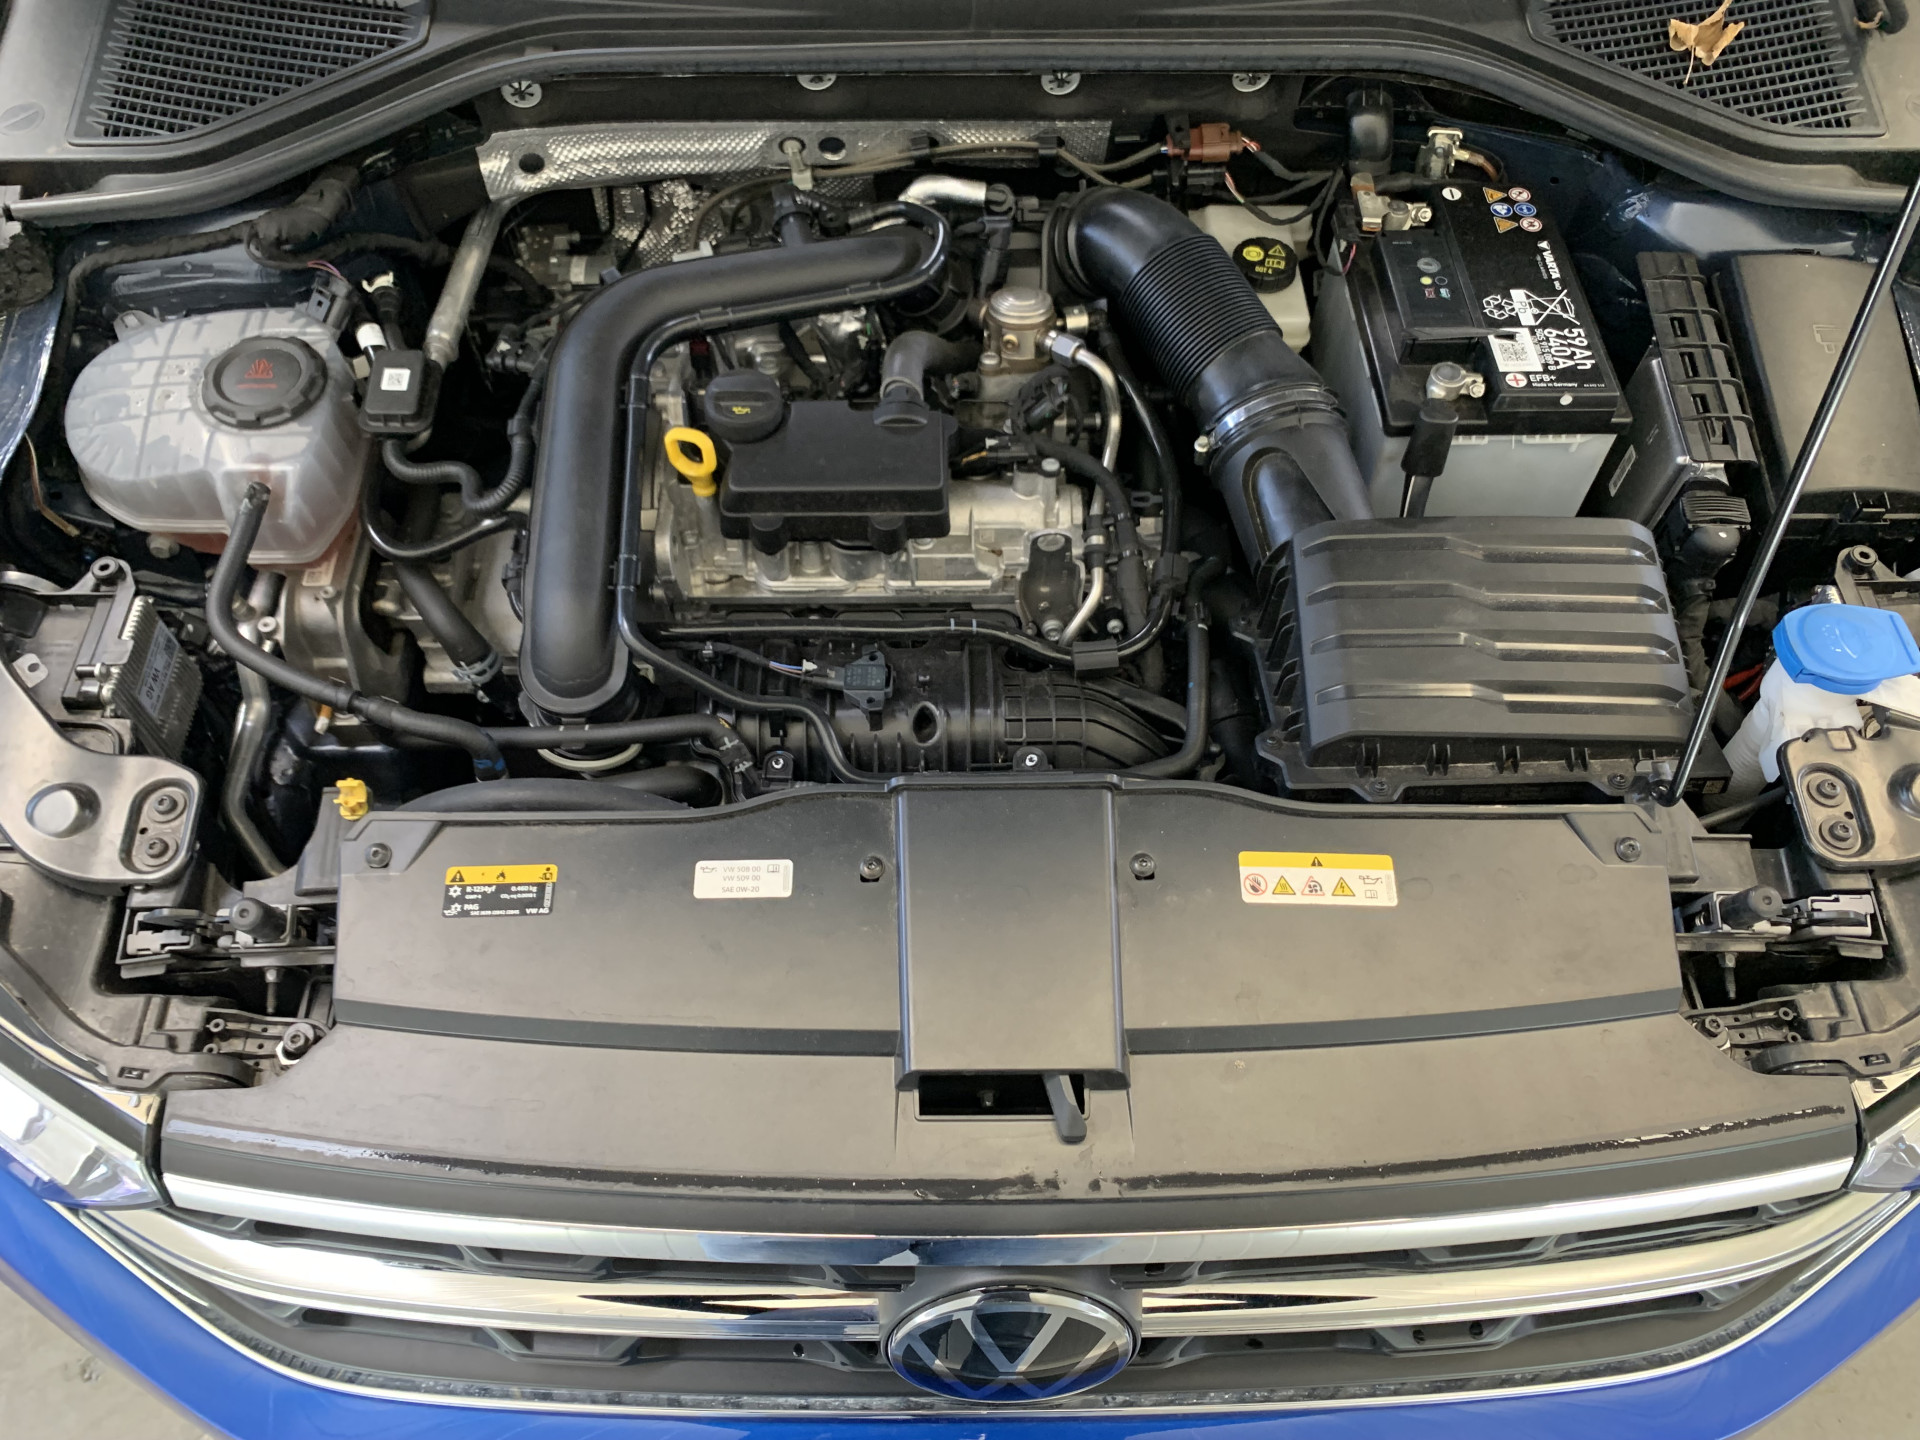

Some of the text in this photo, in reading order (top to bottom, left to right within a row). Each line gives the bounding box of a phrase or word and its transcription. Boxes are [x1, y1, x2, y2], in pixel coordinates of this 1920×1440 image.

[1542, 250, 1561, 279] VARTA
[1516, 300, 1529, 314] Pb
[1539, 342, 1550, 353] 915
[1544, 328, 1576, 370] 640A
[1563, 328, 1595, 370] 59Ah
[1529, 374, 1557, 382] EFB+
[150, 668, 161, 685] VW
[144, 685, 156, 700] AG
[463, 903, 480, 911] PAG
